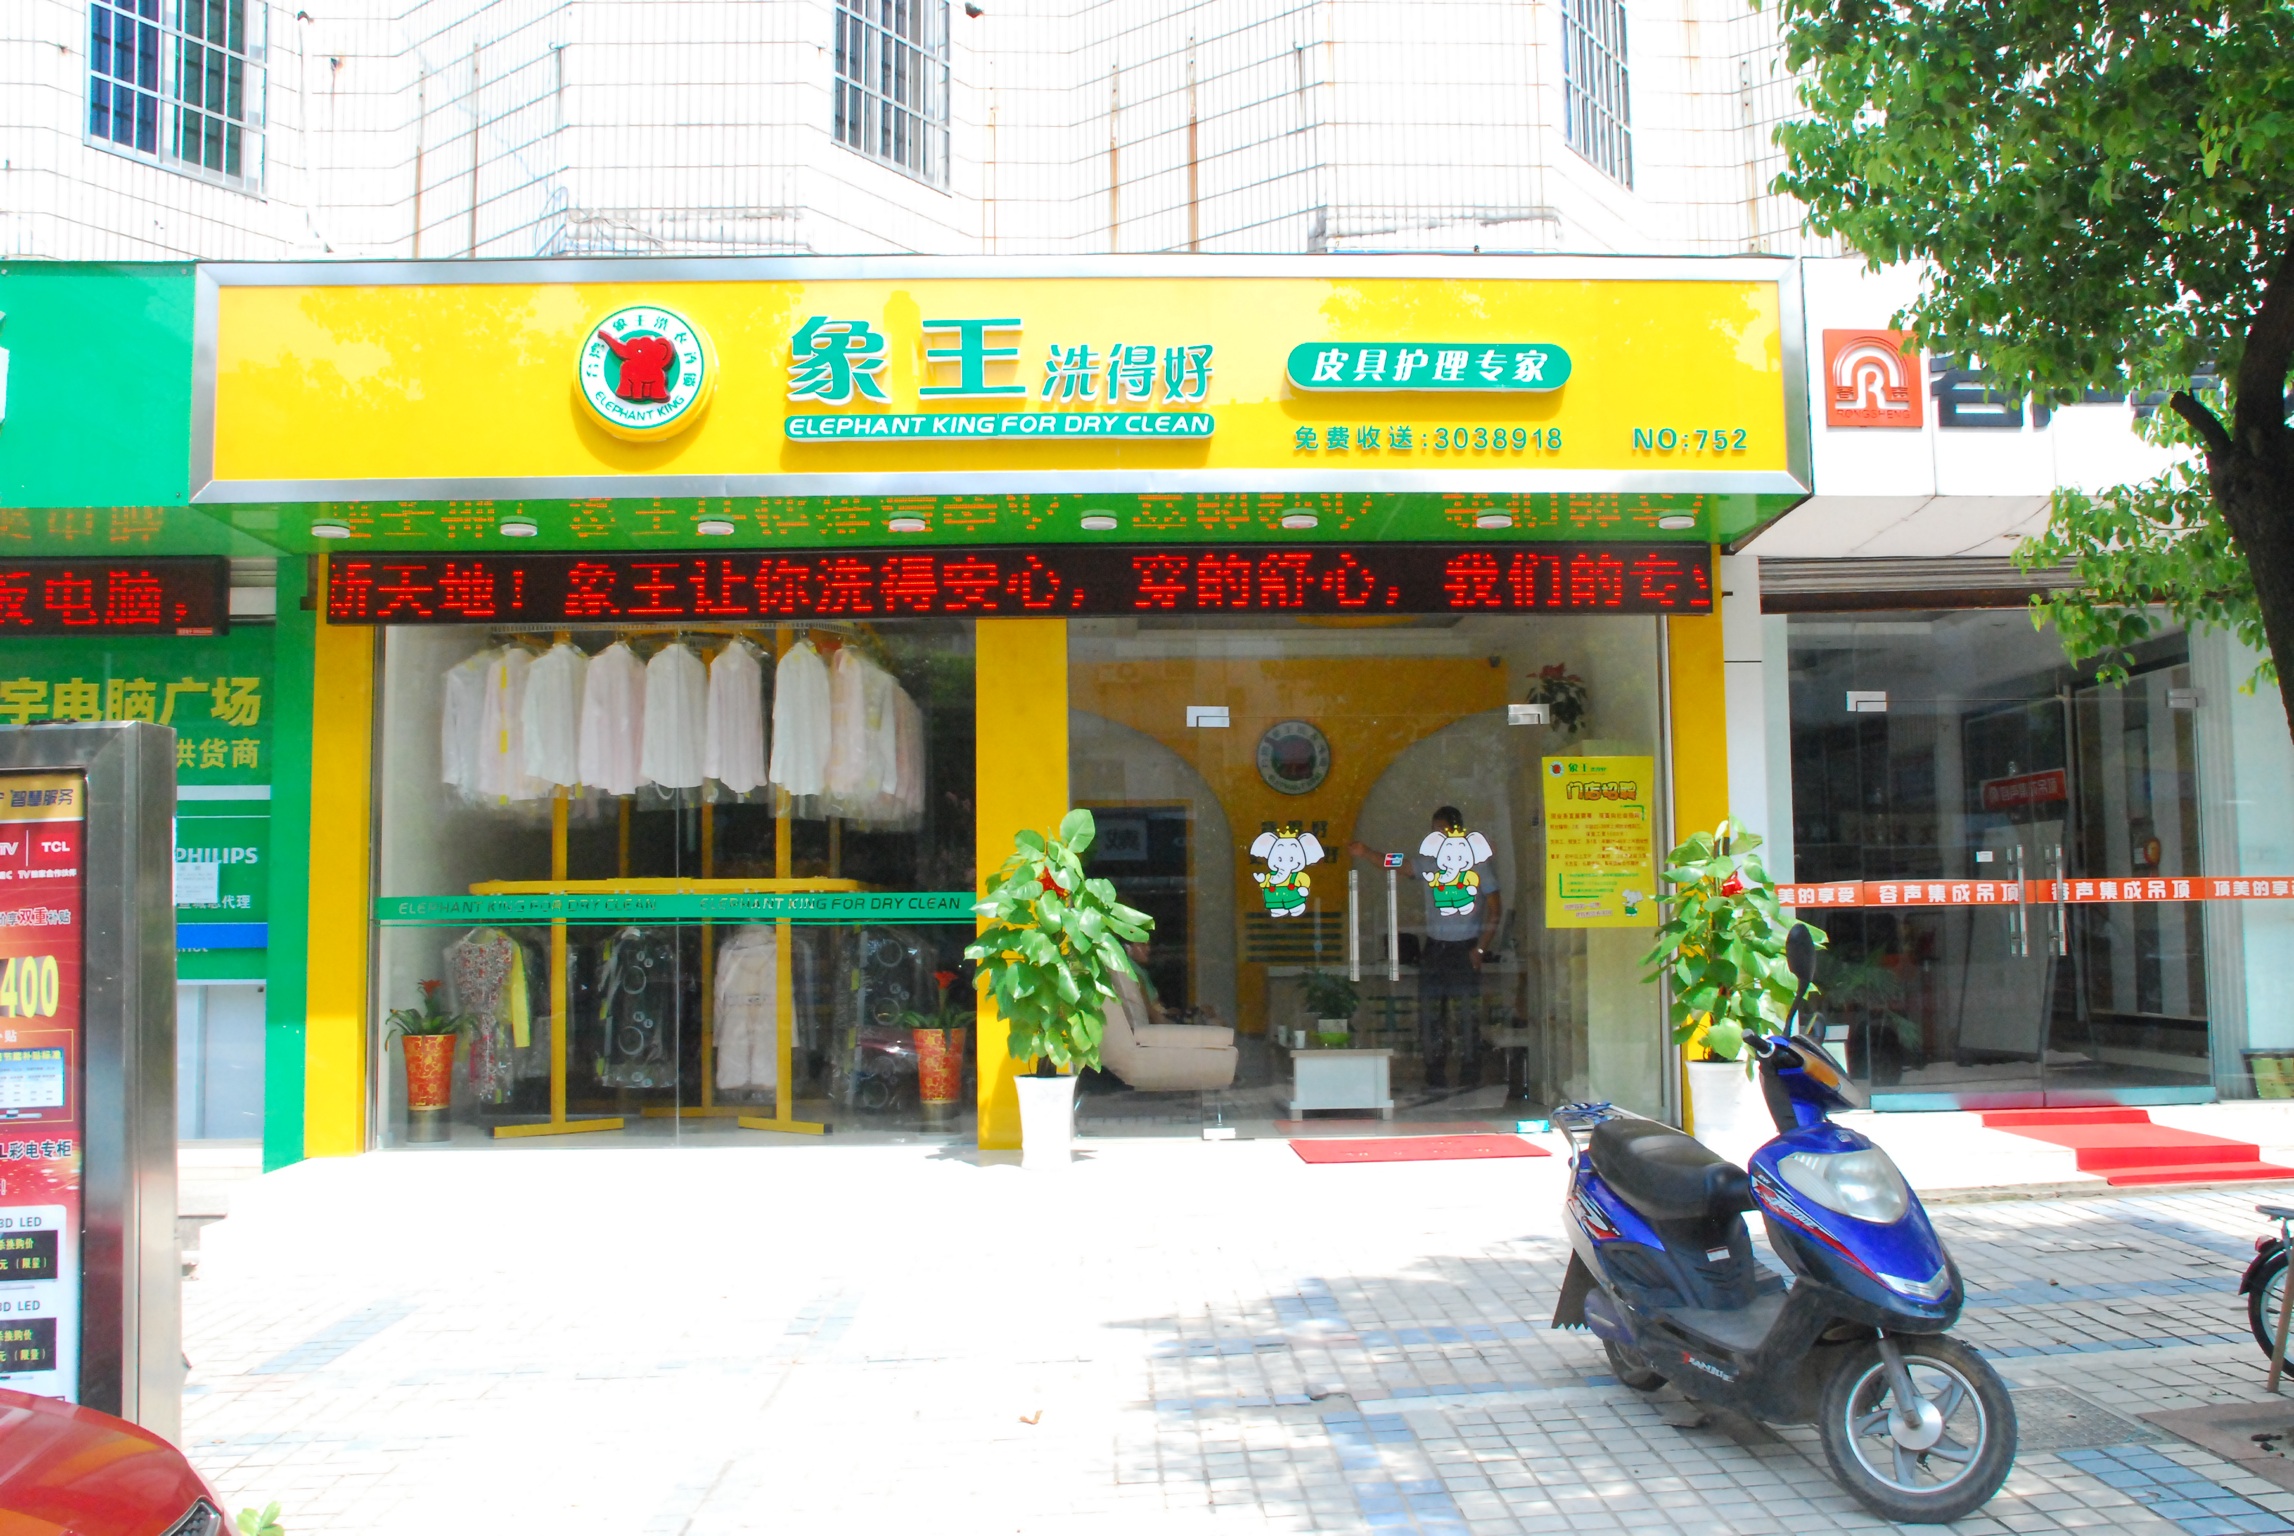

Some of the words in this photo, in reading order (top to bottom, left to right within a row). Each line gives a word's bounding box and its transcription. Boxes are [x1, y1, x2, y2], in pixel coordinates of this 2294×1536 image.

[787, 315, 1027, 402] 象王
[1040, 343, 1214, 403] 洗得好
[1311, 347, 1549, 383] 皮具护理专家
[595, 390, 656, 421] ELEPHANT
[656, 395, 685, 418] KING
[1836, 409, 1911, 419] RONGSHENG
[789, 416, 926, 435] ELEPHANT
[932, 416, 996, 434] KING
[1001, 415, 1055, 434] FOR
[1063, 415, 1118, 433] DRY
[1124, 415, 1210, 433] CLEAN
[1632, 427, 1748, 451] NO:752
[41, 841, 71, 853] TCL
[175, 847, 258, 864] PHILIPS
[1879, 882, 2020, 904] 容声集成吊顶
[2213, 880, 2294, 897] 顶美的享
[398, 901, 484, 914] ELEPHANT
[487, 901, 525, 913] KING
[529, 900, 564, 912] FOR
[567, 900, 600, 912] DRY
[605, 899, 657, 912] CLEAN
[700, 898, 785, 911] ELEPHANT
[787, 898, 827, 910] KING
[831, 898, 865, 911] FOR
[871, 898, 903, 910] DRY
[908, 898, 961, 910] CLEAN
[20, 1216, 42, 1227] LED
[18, 1300, 41, 1311] LED
